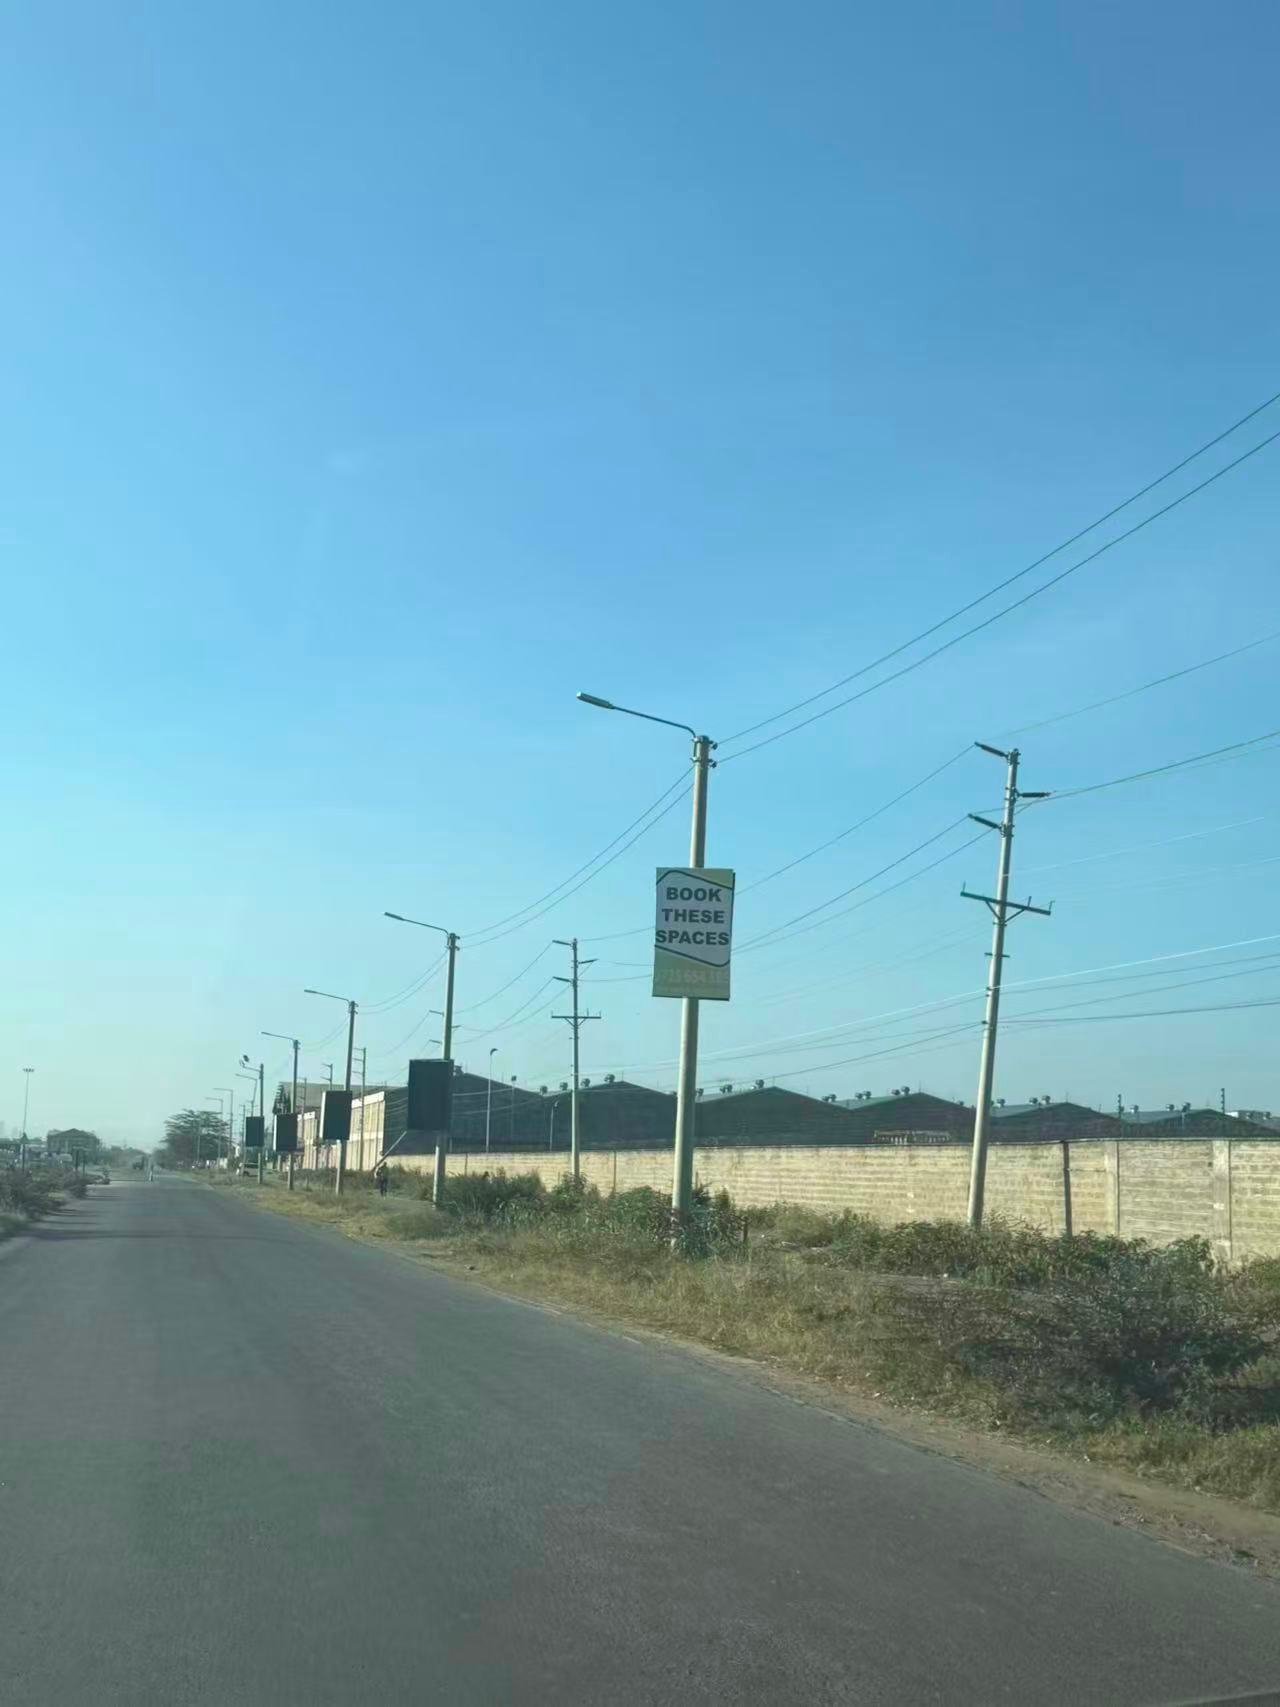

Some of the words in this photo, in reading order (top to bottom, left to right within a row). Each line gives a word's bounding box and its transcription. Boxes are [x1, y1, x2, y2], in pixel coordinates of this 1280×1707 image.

[666, 887, 722, 902] BOOK
[661, 908, 725, 924] THESE
[655, 930, 730, 946] SPACES
